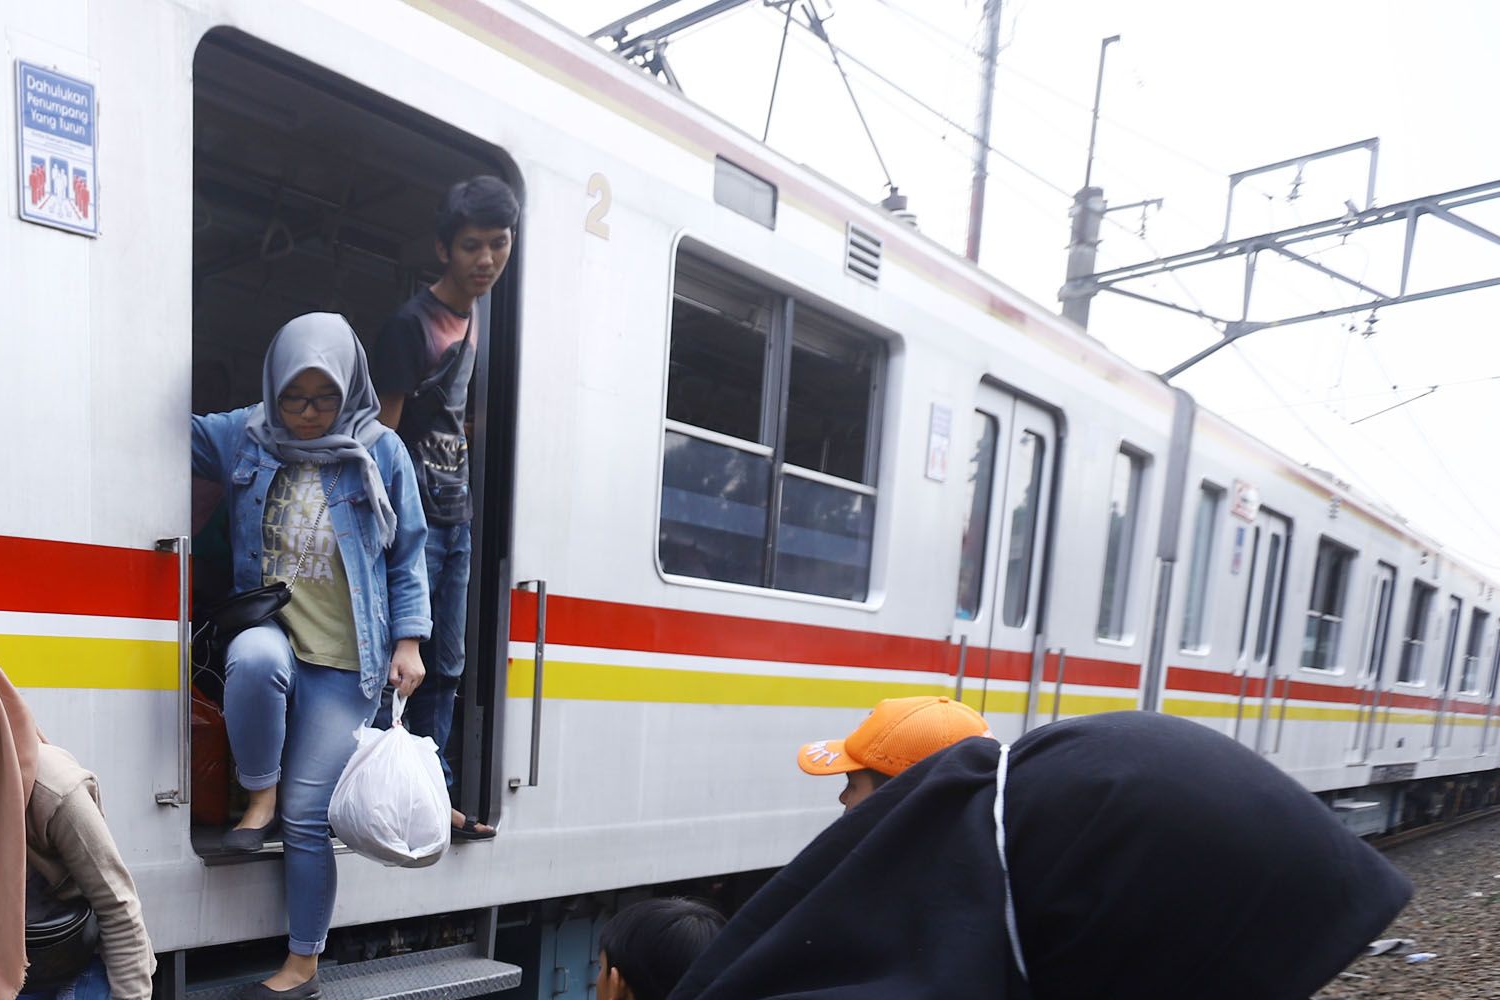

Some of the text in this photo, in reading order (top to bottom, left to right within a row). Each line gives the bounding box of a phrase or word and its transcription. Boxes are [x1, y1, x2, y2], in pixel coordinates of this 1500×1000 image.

[27, 74, 88, 107] Dahulukan
[27, 91, 88, 125] Penumpang
[31, 107, 85, 136] Yang Turun
[585, 172, 612, 241] 2
